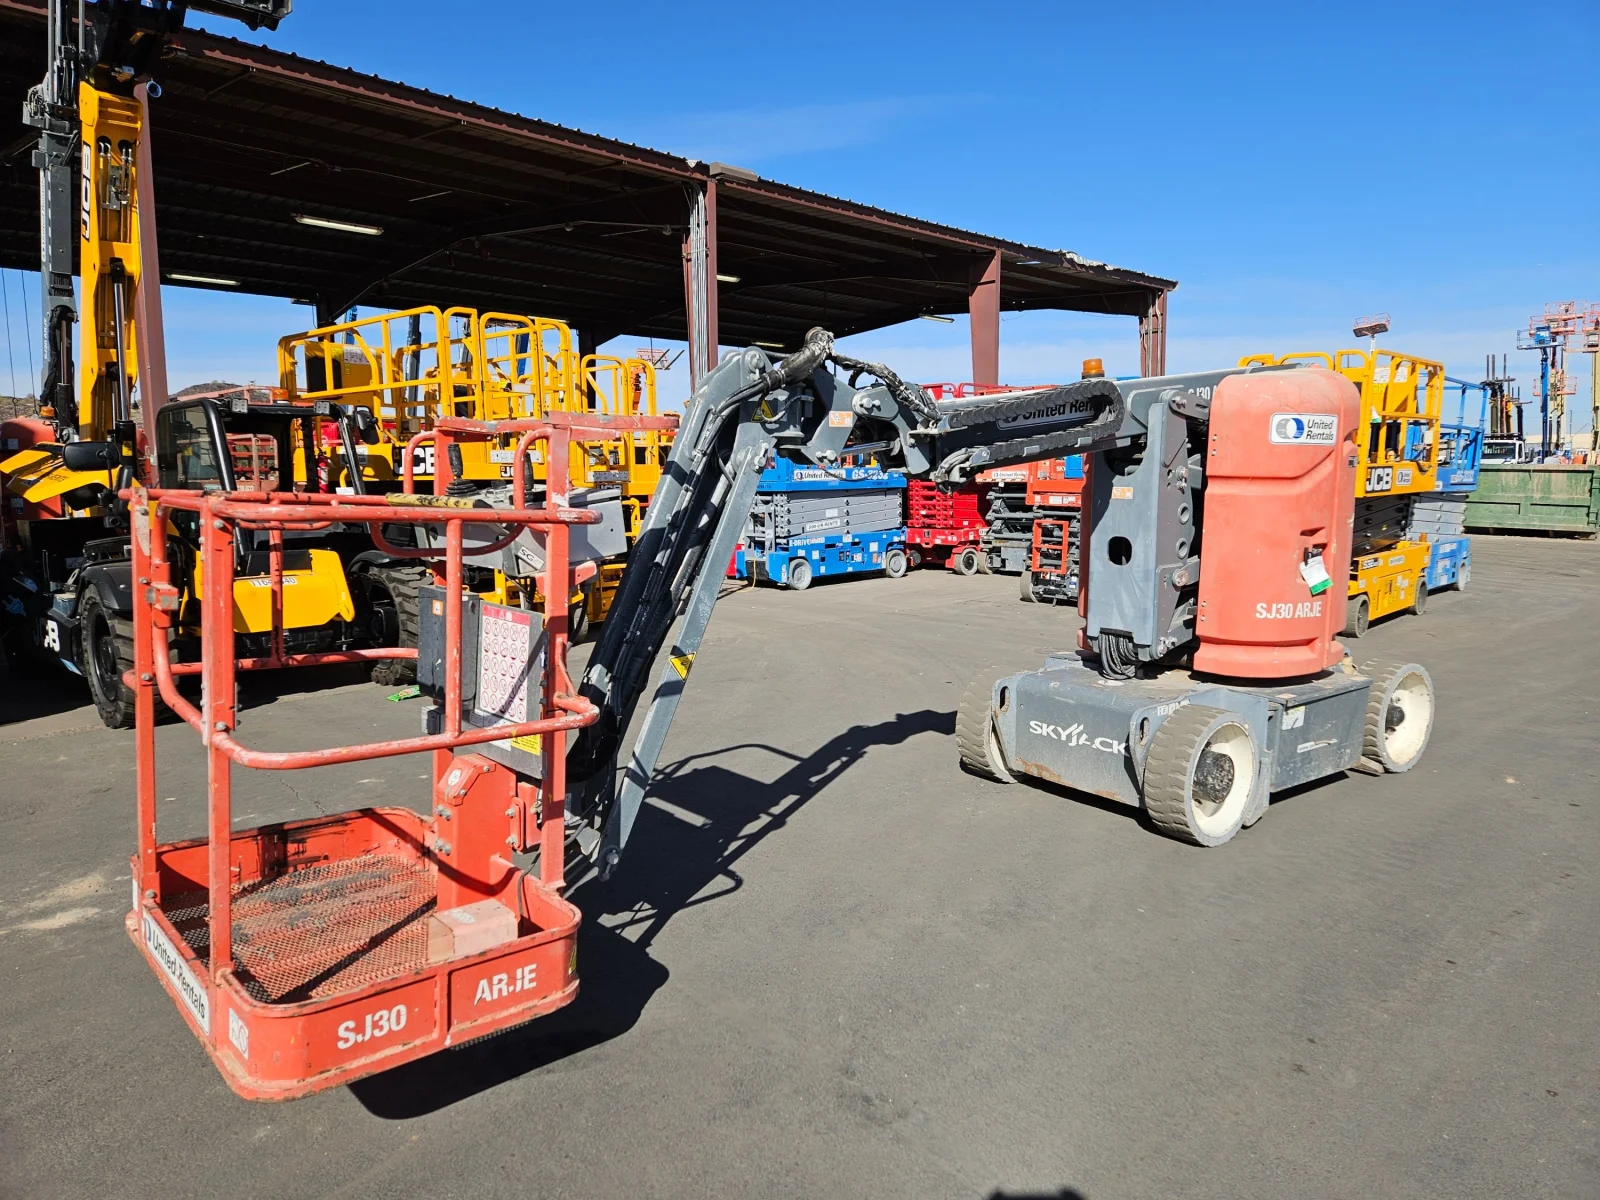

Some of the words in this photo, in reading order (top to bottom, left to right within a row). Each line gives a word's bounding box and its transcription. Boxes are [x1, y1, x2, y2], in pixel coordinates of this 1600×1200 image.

[82, 143, 91, 240] JCB
[1305, 430, 1334, 441] Rentals
[1307, 419, 1333, 430] United
[804, 471, 823, 479] United
[1366, 467, 1393, 492] JCB
[1256, 603, 1293, 619] SJ30
[1294, 601, 1322, 618] ARJE
[1029, 720, 1130, 757] SKYJACK
[152, 929, 177, 976] United
[176, 963, 206, 1020] Rentals
[337, 1004, 408, 1050] SJ30
[473, 963, 538, 1007] ARJE
